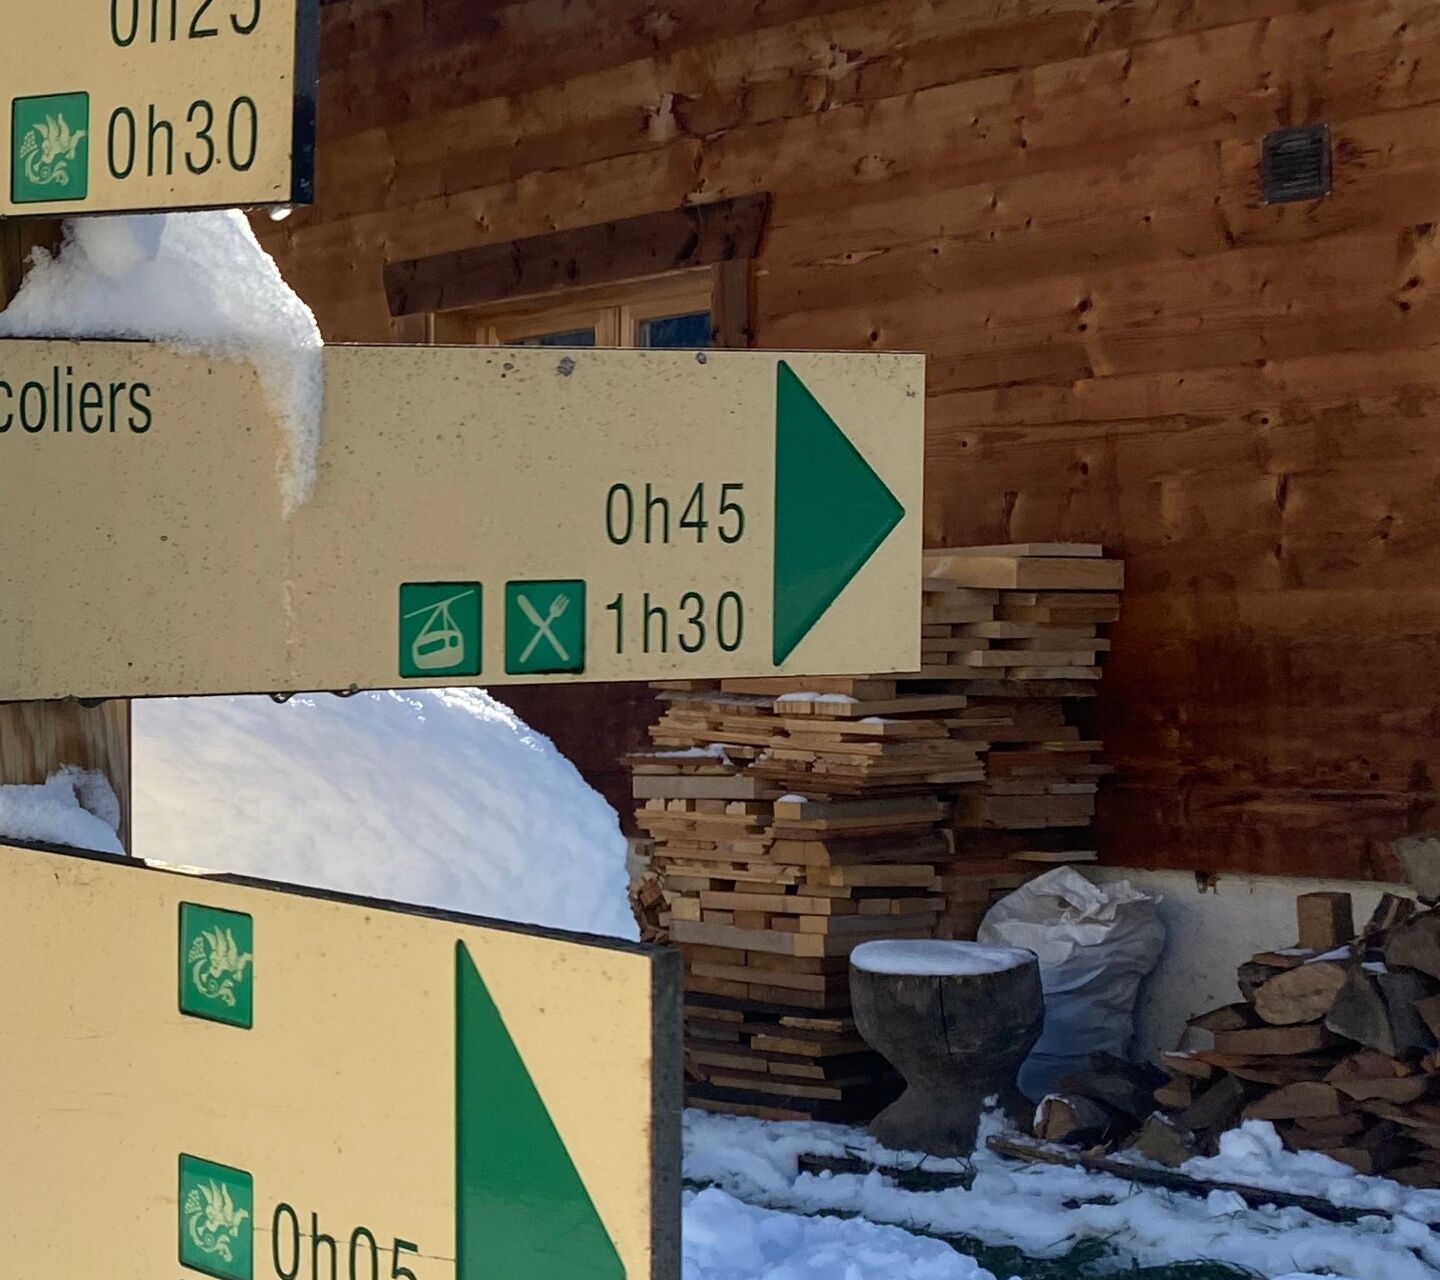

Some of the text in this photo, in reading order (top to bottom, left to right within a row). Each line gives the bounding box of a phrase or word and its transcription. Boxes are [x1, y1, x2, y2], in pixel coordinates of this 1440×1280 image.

[108, 96, 257, 179] 0h30
[606, 483, 744, 545] 0h45
[607, 591, 743, 654] 1h30
